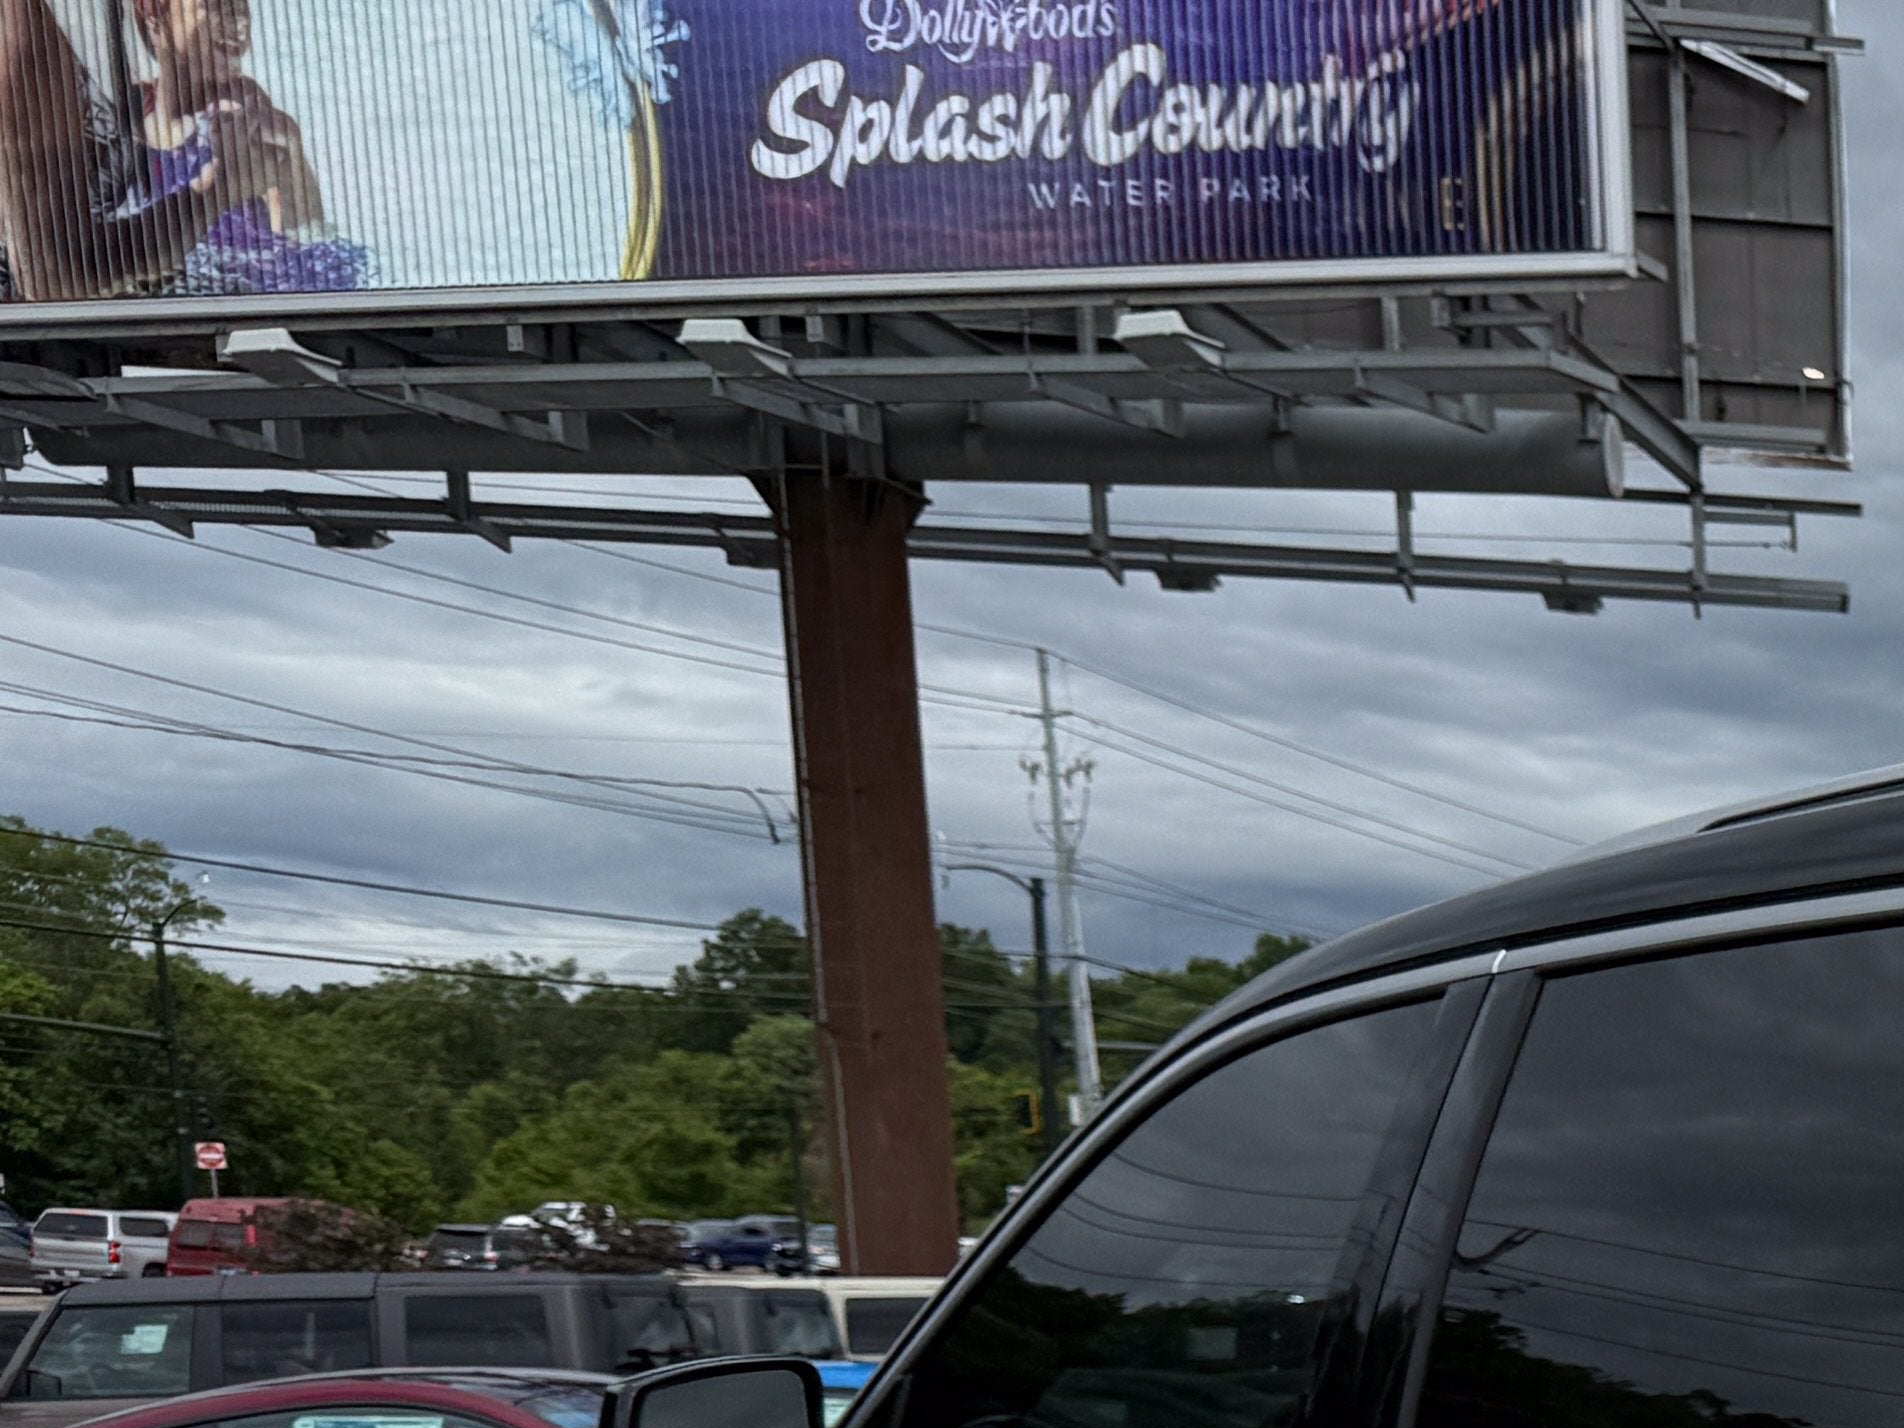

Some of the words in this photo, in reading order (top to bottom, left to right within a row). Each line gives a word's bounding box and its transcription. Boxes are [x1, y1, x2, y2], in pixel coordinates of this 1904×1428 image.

[751, 59, 1071, 187] Splash
[1083, 43, 1419, 173] Country
[1028, 178, 1174, 209] WATER
[1201, 175, 1312, 202] PARK
